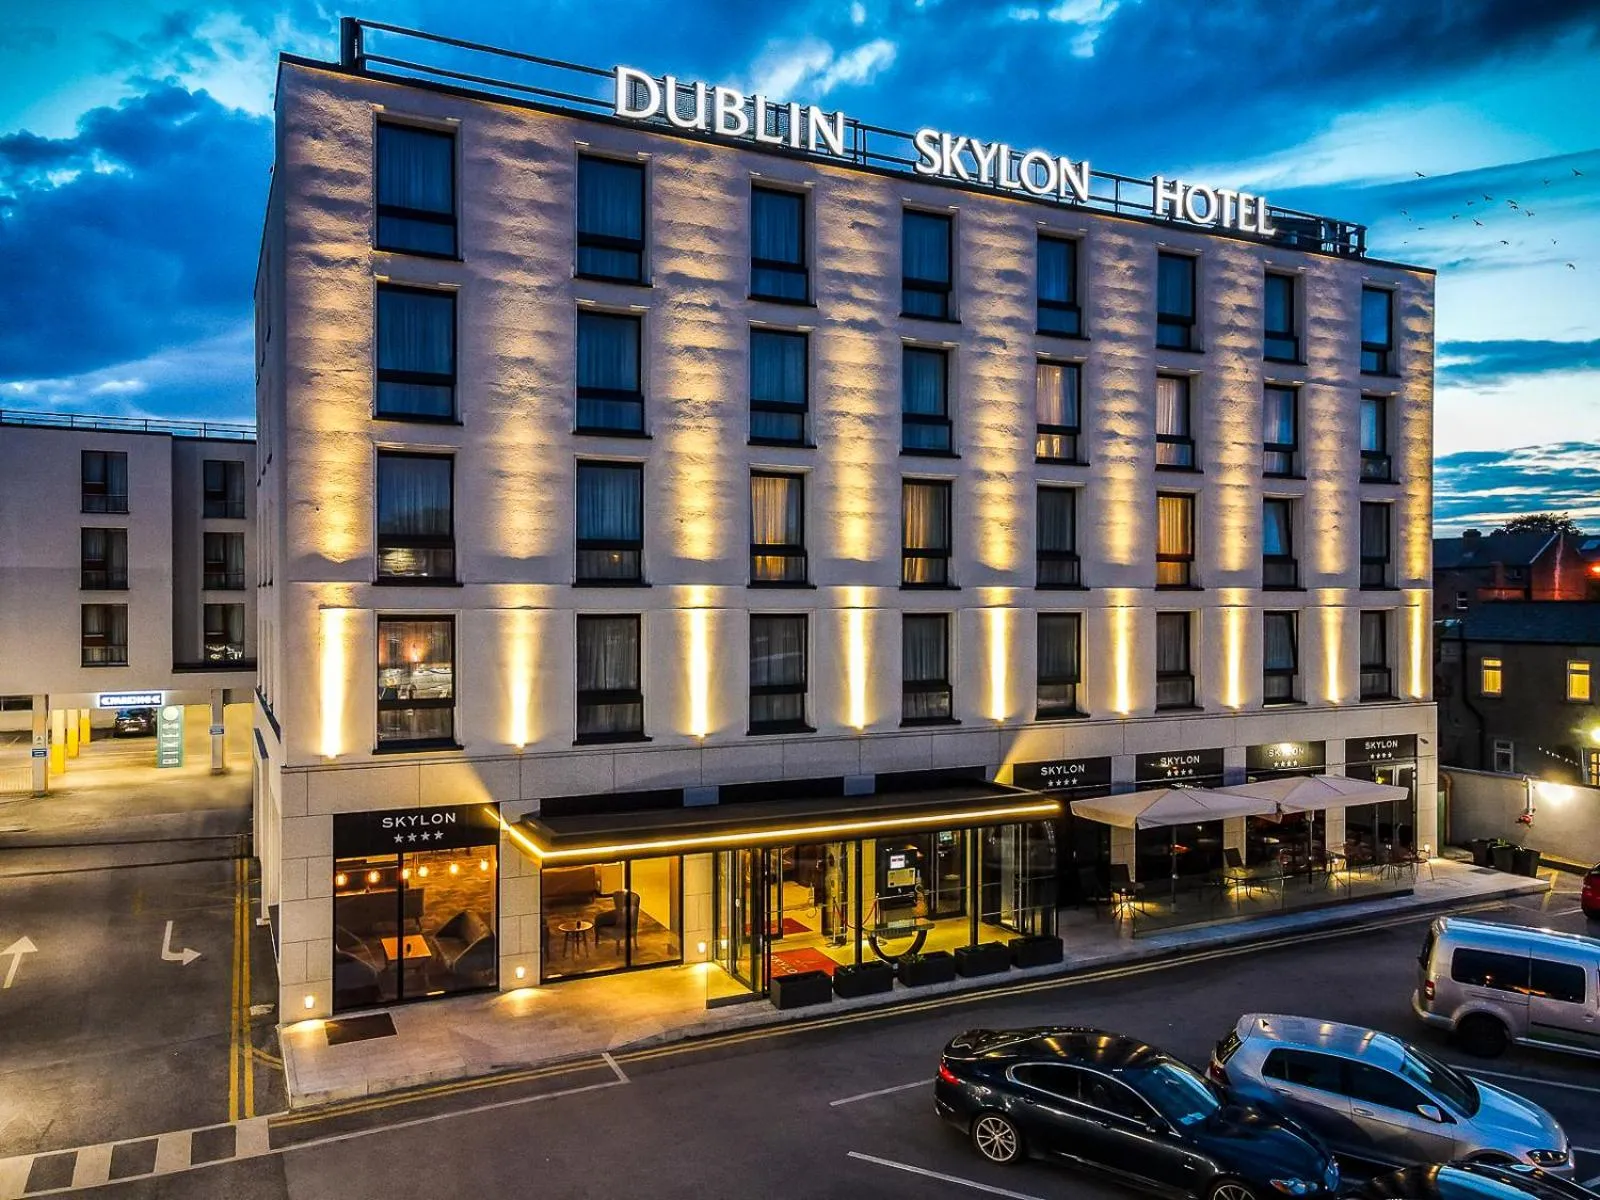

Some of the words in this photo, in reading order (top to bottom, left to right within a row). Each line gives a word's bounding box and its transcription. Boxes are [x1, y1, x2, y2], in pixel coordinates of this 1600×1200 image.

[614, 66, 846, 156] DUBLIN
[913, 128, 1090, 202] SKYLON
[1152, 175, 1276, 236] HOTEL
[1365, 740, 1398, 750] SKYLON
[1268, 746, 1305, 758] SKON
[1160, 755, 1200, 766] SKYLON
[1040, 764, 1085, 776] SKYLON
[382, 813, 456, 828] SKYLON
